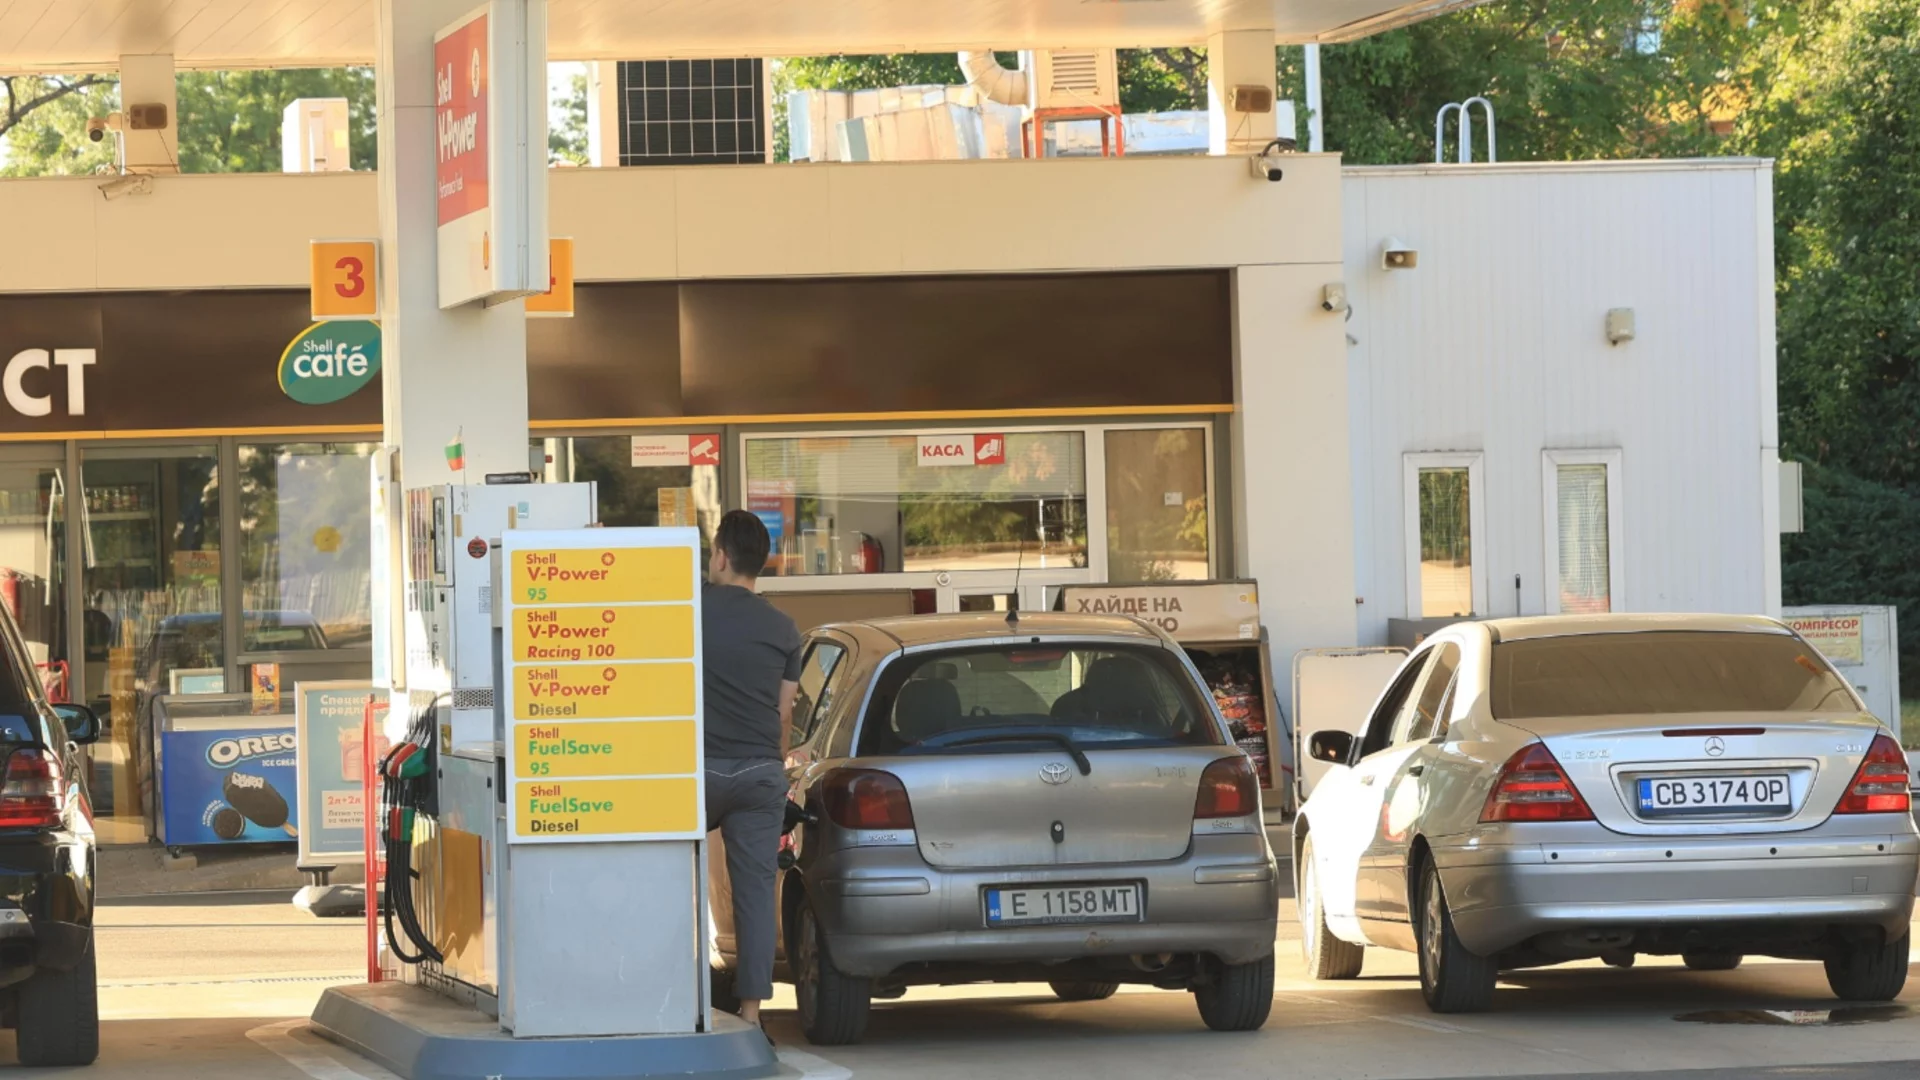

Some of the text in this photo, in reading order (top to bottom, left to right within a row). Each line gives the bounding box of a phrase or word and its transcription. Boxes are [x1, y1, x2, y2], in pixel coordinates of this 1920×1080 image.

[438, 63, 452, 106] Shell
[438, 109, 477, 163] V-Power
[334, 256, 365, 298] 3
[303, 339, 333, 352] Shell
[293, 342, 368, 378] café
[3, 348, 97, 417] CT
[922, 444, 965, 457] КАСА
[526, 553, 556, 565] Shell
[527, 567, 609, 582] V-Power
[527, 588, 548, 601] 95
[1077, 595, 1183, 615] ХАЙДЕ НА
[527, 610, 557, 622] Shell
[528, 624, 610, 639] V-Power
[527, 644, 615, 661] Racing 100
[527, 668, 558, 681] Shell
[529, 682, 611, 697] V-Power
[528, 702, 577, 717] Diesel
[529, 727, 559, 739] Shell
[210, 733, 297, 764] OREO
[528, 740, 613, 755] FuelSave
[262, 758, 297, 767] ICE CREA
[530, 762, 550, 775] 95
[530, 785, 561, 797] Shell
[1655, 779, 1784, 806] CB 3174 OP
[529, 798, 614, 814] FuelSave
[530, 819, 579, 832] Diesel
[1011, 889, 1132, 916] E 1158 MT
